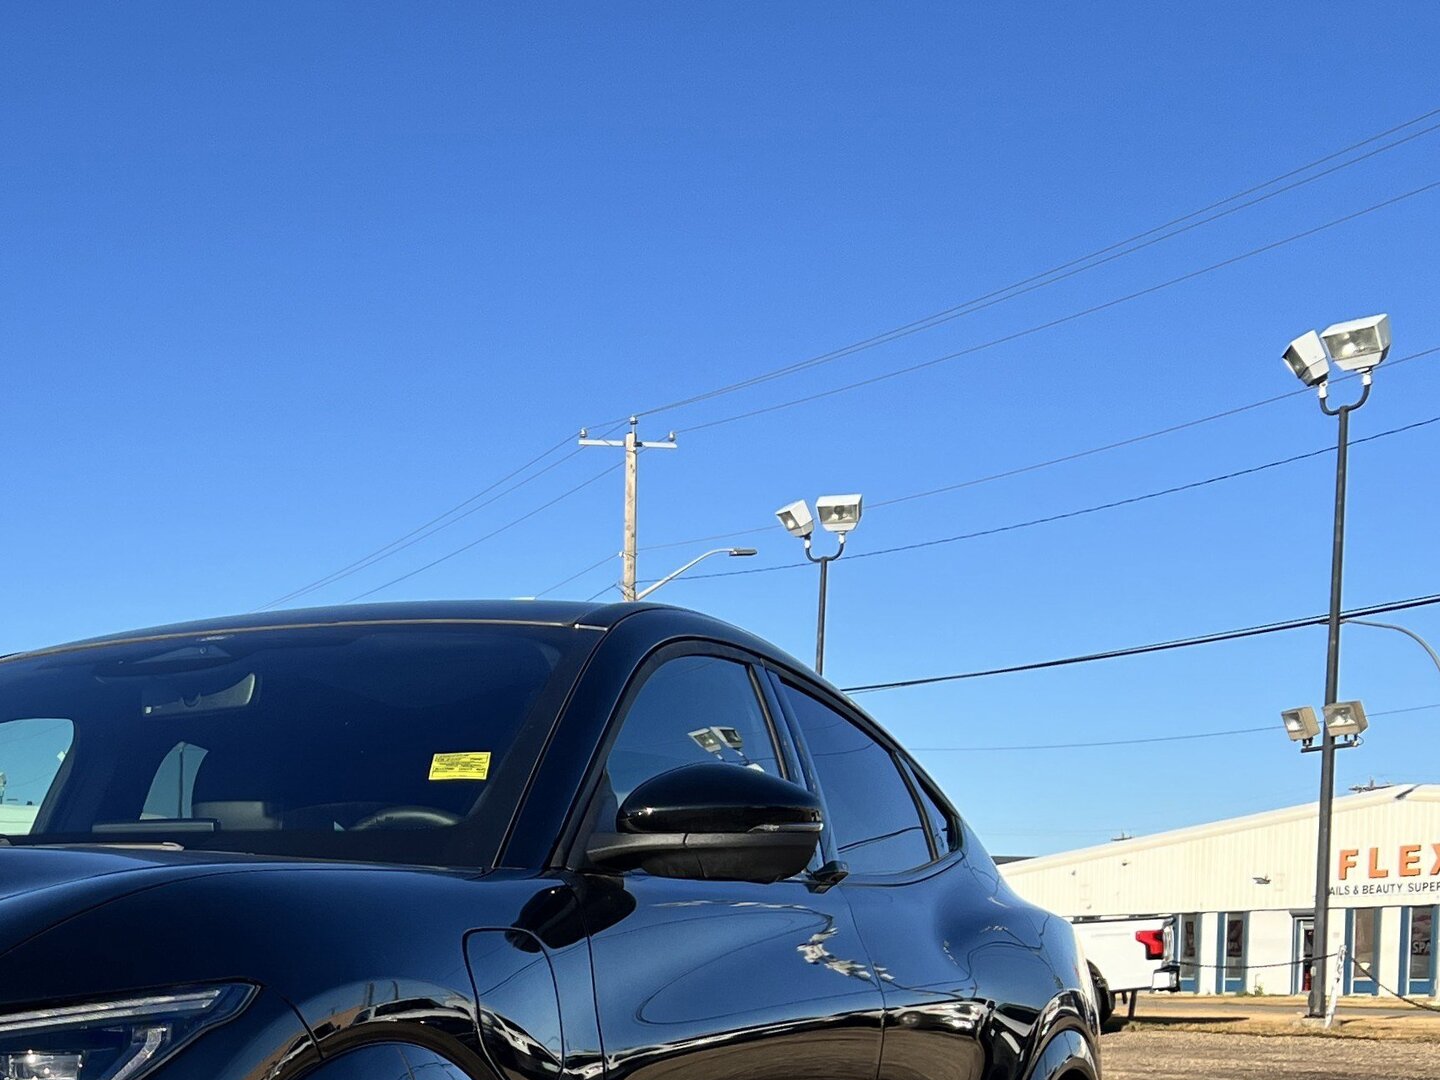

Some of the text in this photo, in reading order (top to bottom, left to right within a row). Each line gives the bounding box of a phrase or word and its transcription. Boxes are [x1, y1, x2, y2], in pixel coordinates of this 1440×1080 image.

[1329, 884, 1350, 896] AILS
[1353, 884, 1359, 895] &
[1362, 883, 1403, 895] BEAUTY
